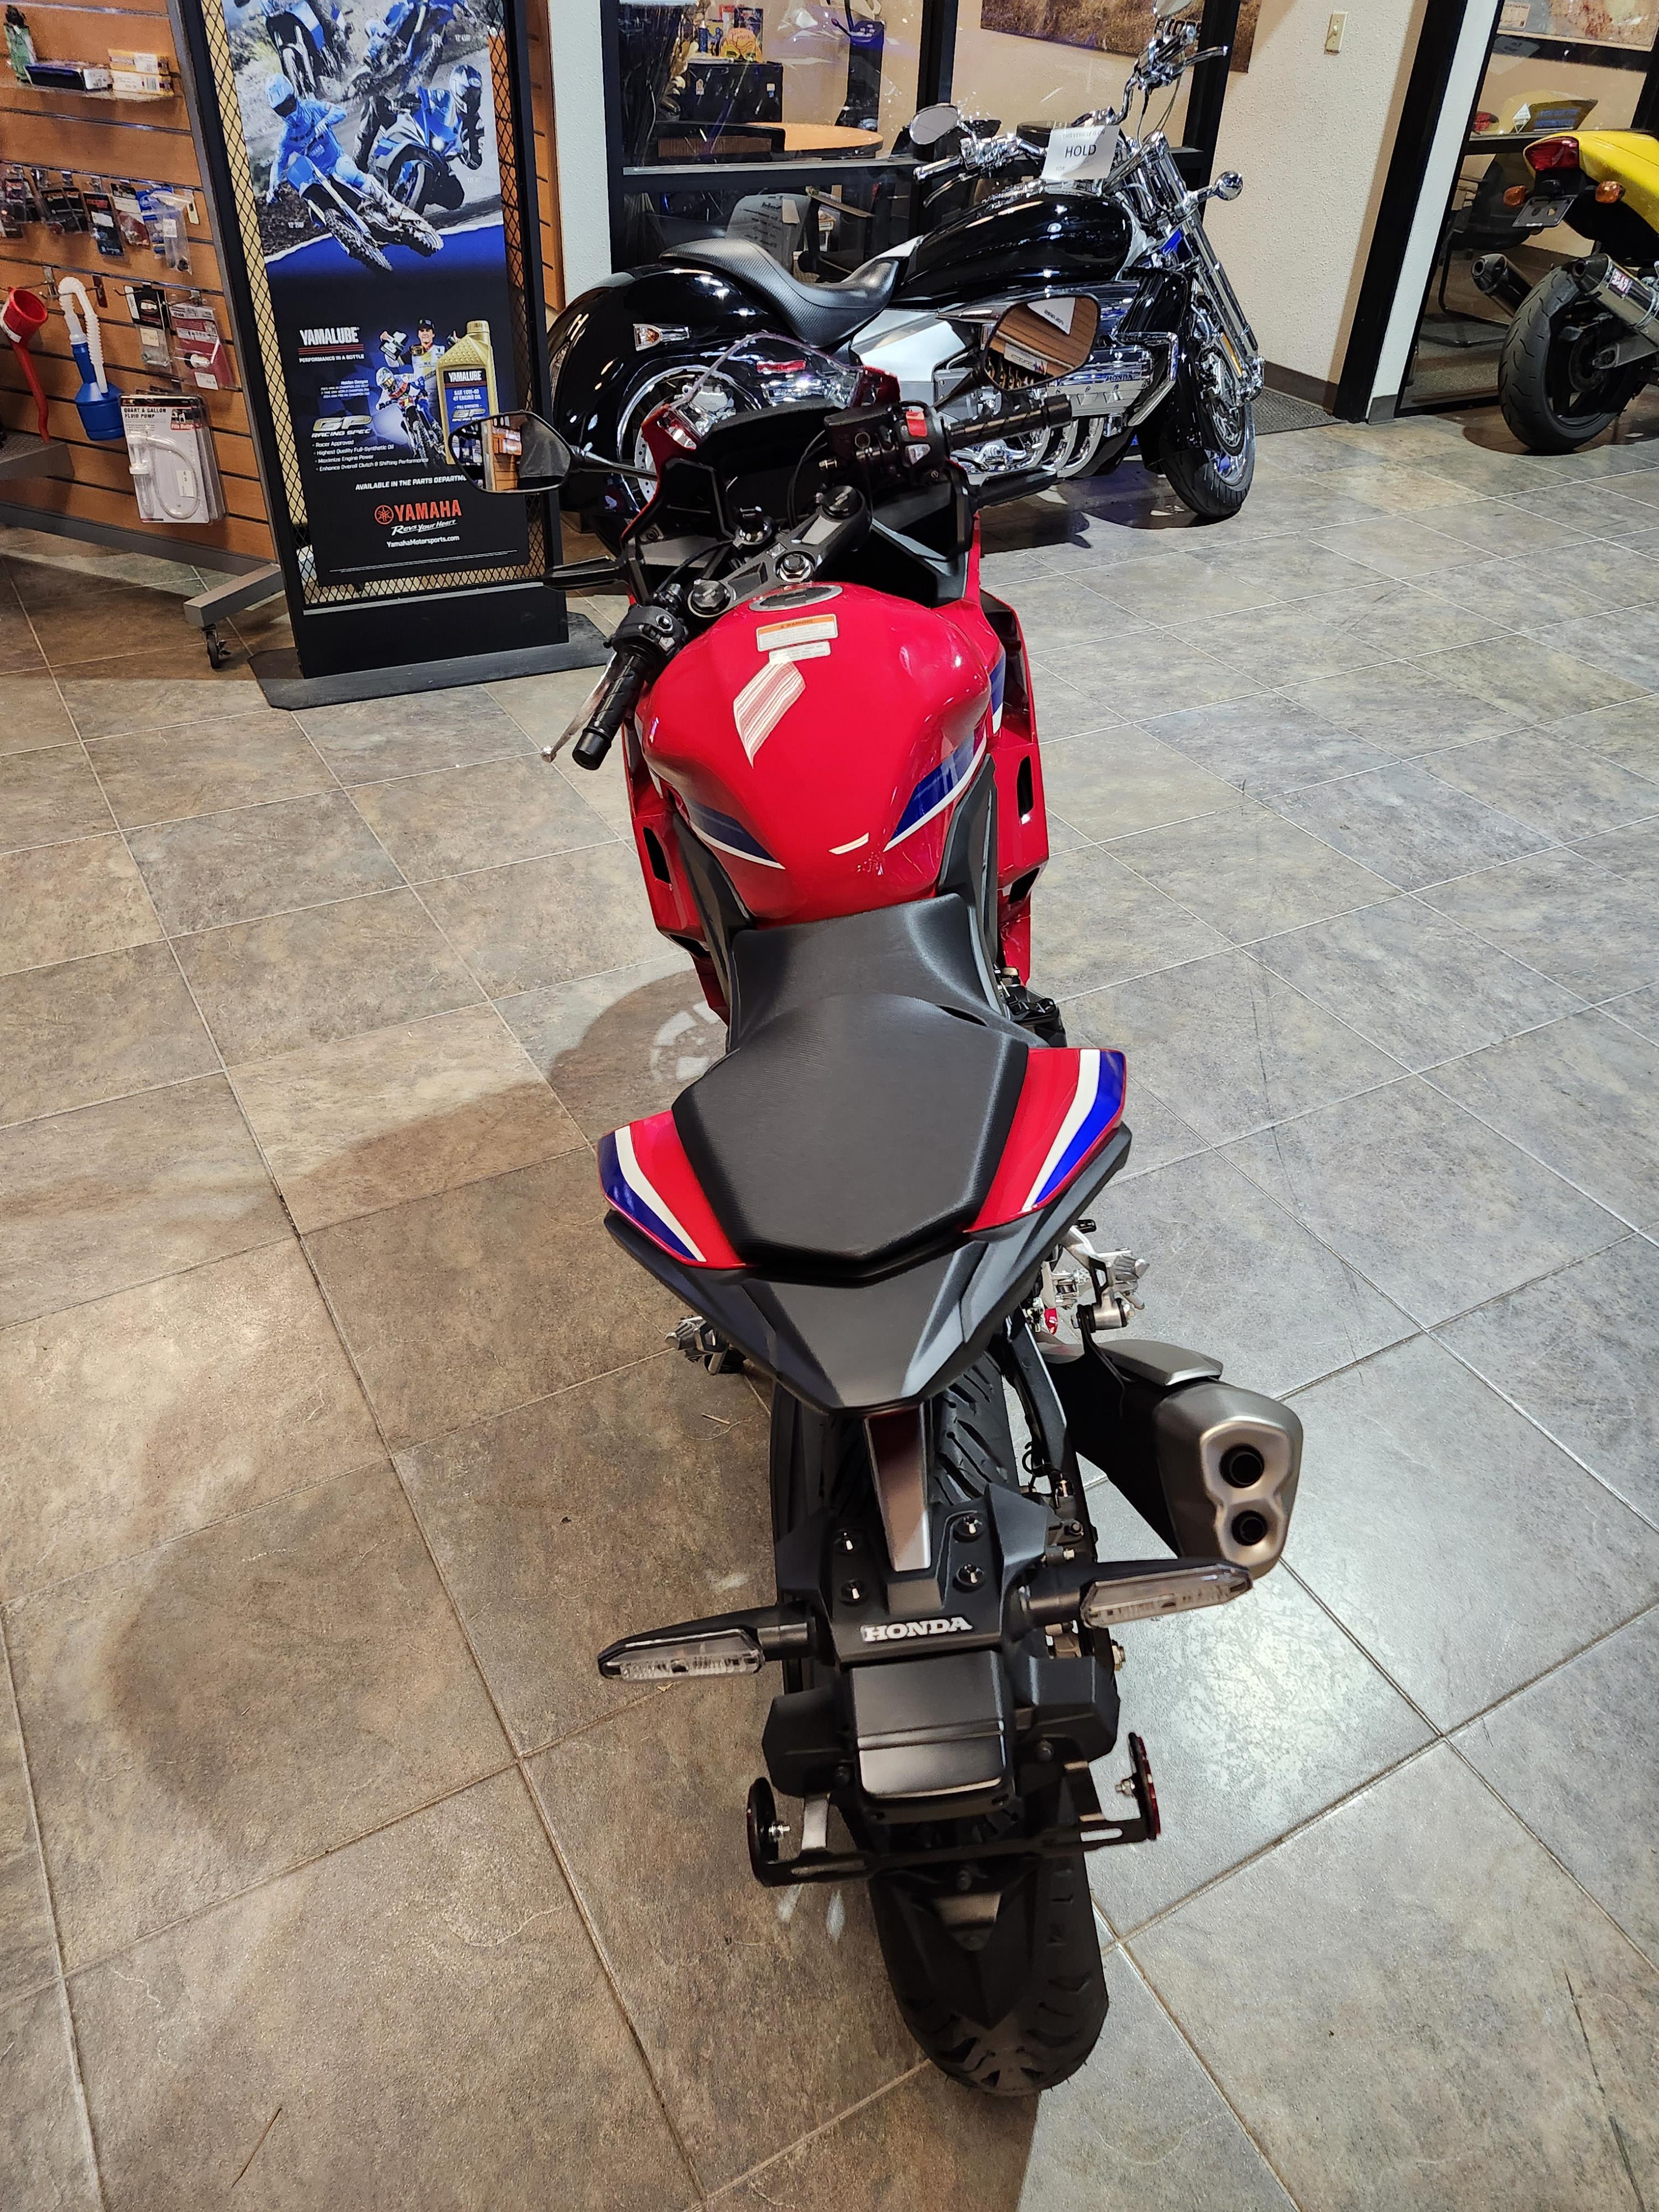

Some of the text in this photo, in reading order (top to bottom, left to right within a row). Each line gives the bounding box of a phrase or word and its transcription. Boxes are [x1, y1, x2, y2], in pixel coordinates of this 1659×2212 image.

[1065, 144, 1097, 158] HOLD
[299, 327, 359, 346] YAMALUBE
[448, 371, 482, 382] YAMALUBE
[313, 415, 372, 432] GP
[354, 445, 387, 453] Full-Synthetic
[355, 482, 390, 491] AVAILABLE
[394, 499, 462, 522] YAMAHA
[391, 525, 418, 536] Revs
[418, 523, 437, 533] Your
[387, 535, 460, 548] YamahaMotorsports.com
[864, 1616, 973, 1642] HONDA
